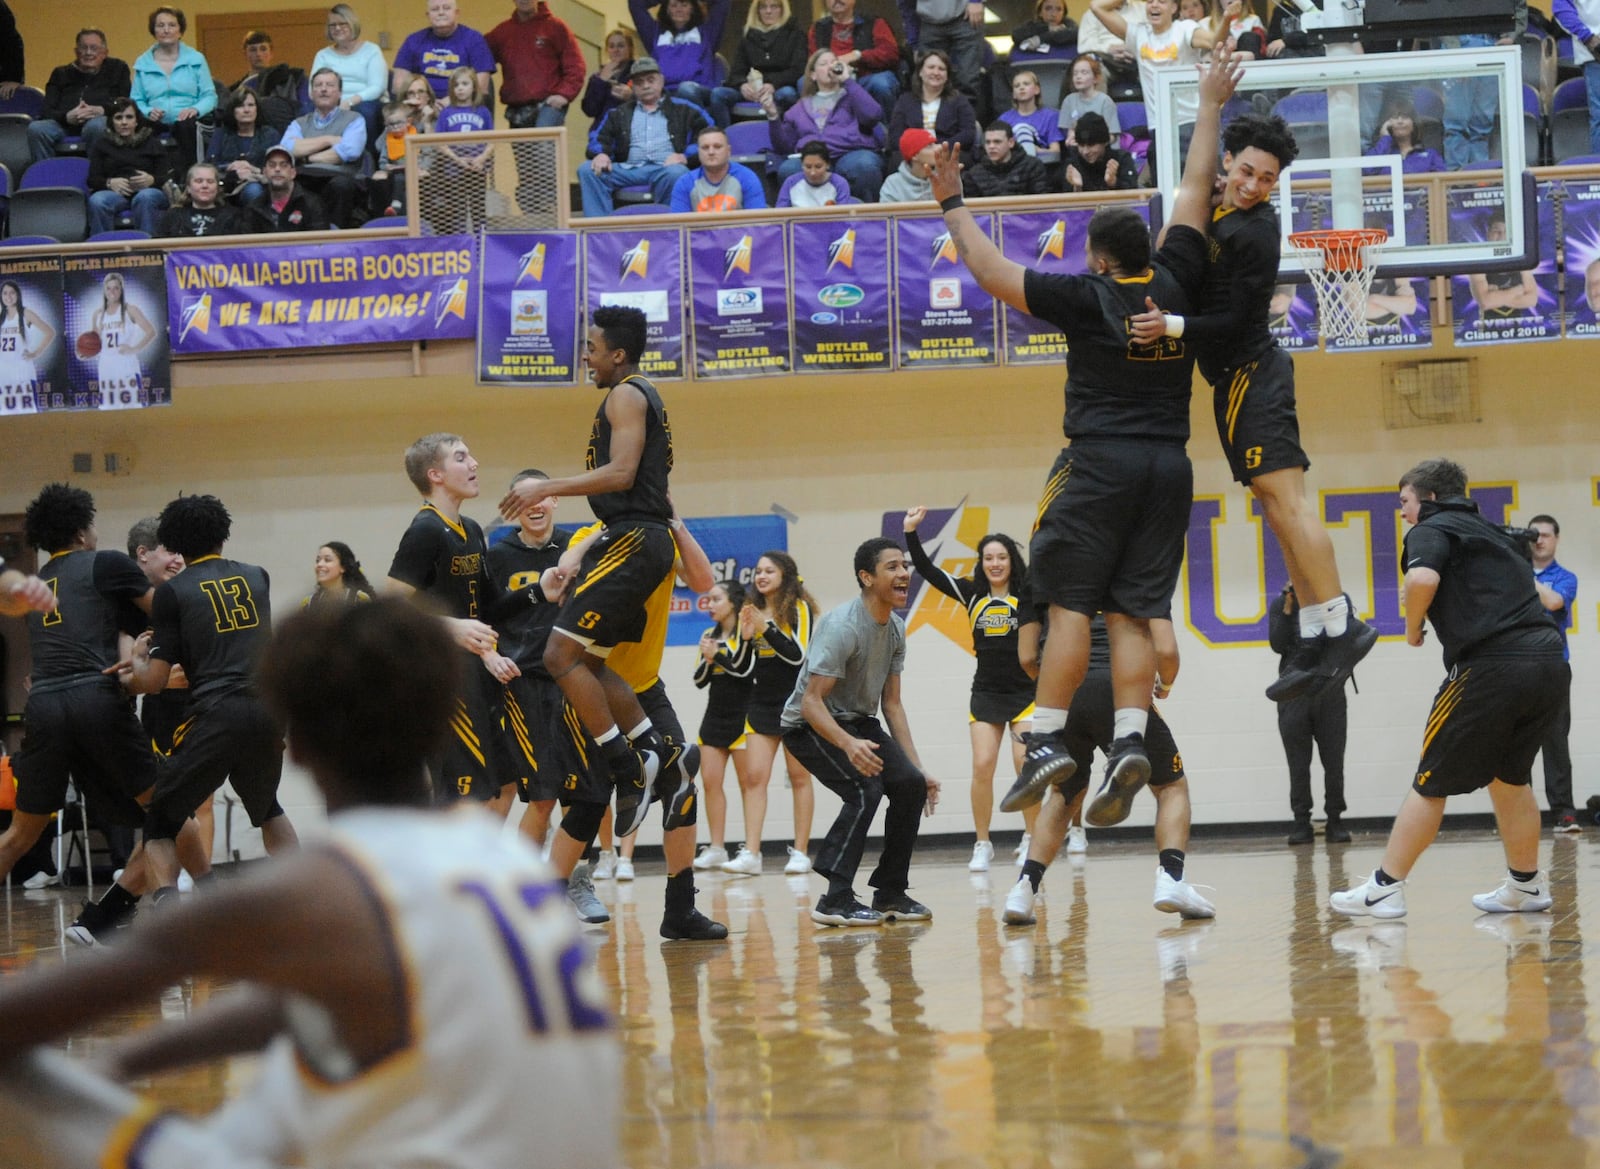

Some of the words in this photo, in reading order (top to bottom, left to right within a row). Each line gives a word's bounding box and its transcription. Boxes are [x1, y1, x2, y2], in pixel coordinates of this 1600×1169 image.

[103, 254, 164, 268] BASKETBALL
[175, 256, 359, 290] VANDALIA-BUTLER
[363, 249, 472, 281] BOOSTERS
[219, 302, 251, 328] WE
[257, 301, 302, 326] ARE
[307, 291, 432, 323] AVIATORS!
[1335, 335, 1370, 347] Class
[1372, 334, 1385, 345] of
[1387, 333, 1417, 344] 2018
[1464, 330, 1499, 341] Class
[1502, 328, 1515, 339] of
[1517, 326, 1546, 337] 2018
[816, 341, 869, 353] BUTLER
[921, 336, 975, 349] BUTLER
[502, 354, 555, 365] BUTLER
[717, 346, 770, 359] BUTLER
[802, 352, 884, 365] WRESTLING
[907, 347, 989, 360] WRESTLING
[703, 356, 785, 370] WRESTLING
[487, 365, 569, 377] WRESTLING
[87, 377, 151, 391] WILLOW
[74, 387, 165, 410] KNIGHT
[1245, 445, 1263, 469] S
[200, 575, 260, 633] 13
[577, 610, 602, 631] S
[457, 775, 473, 796] S
